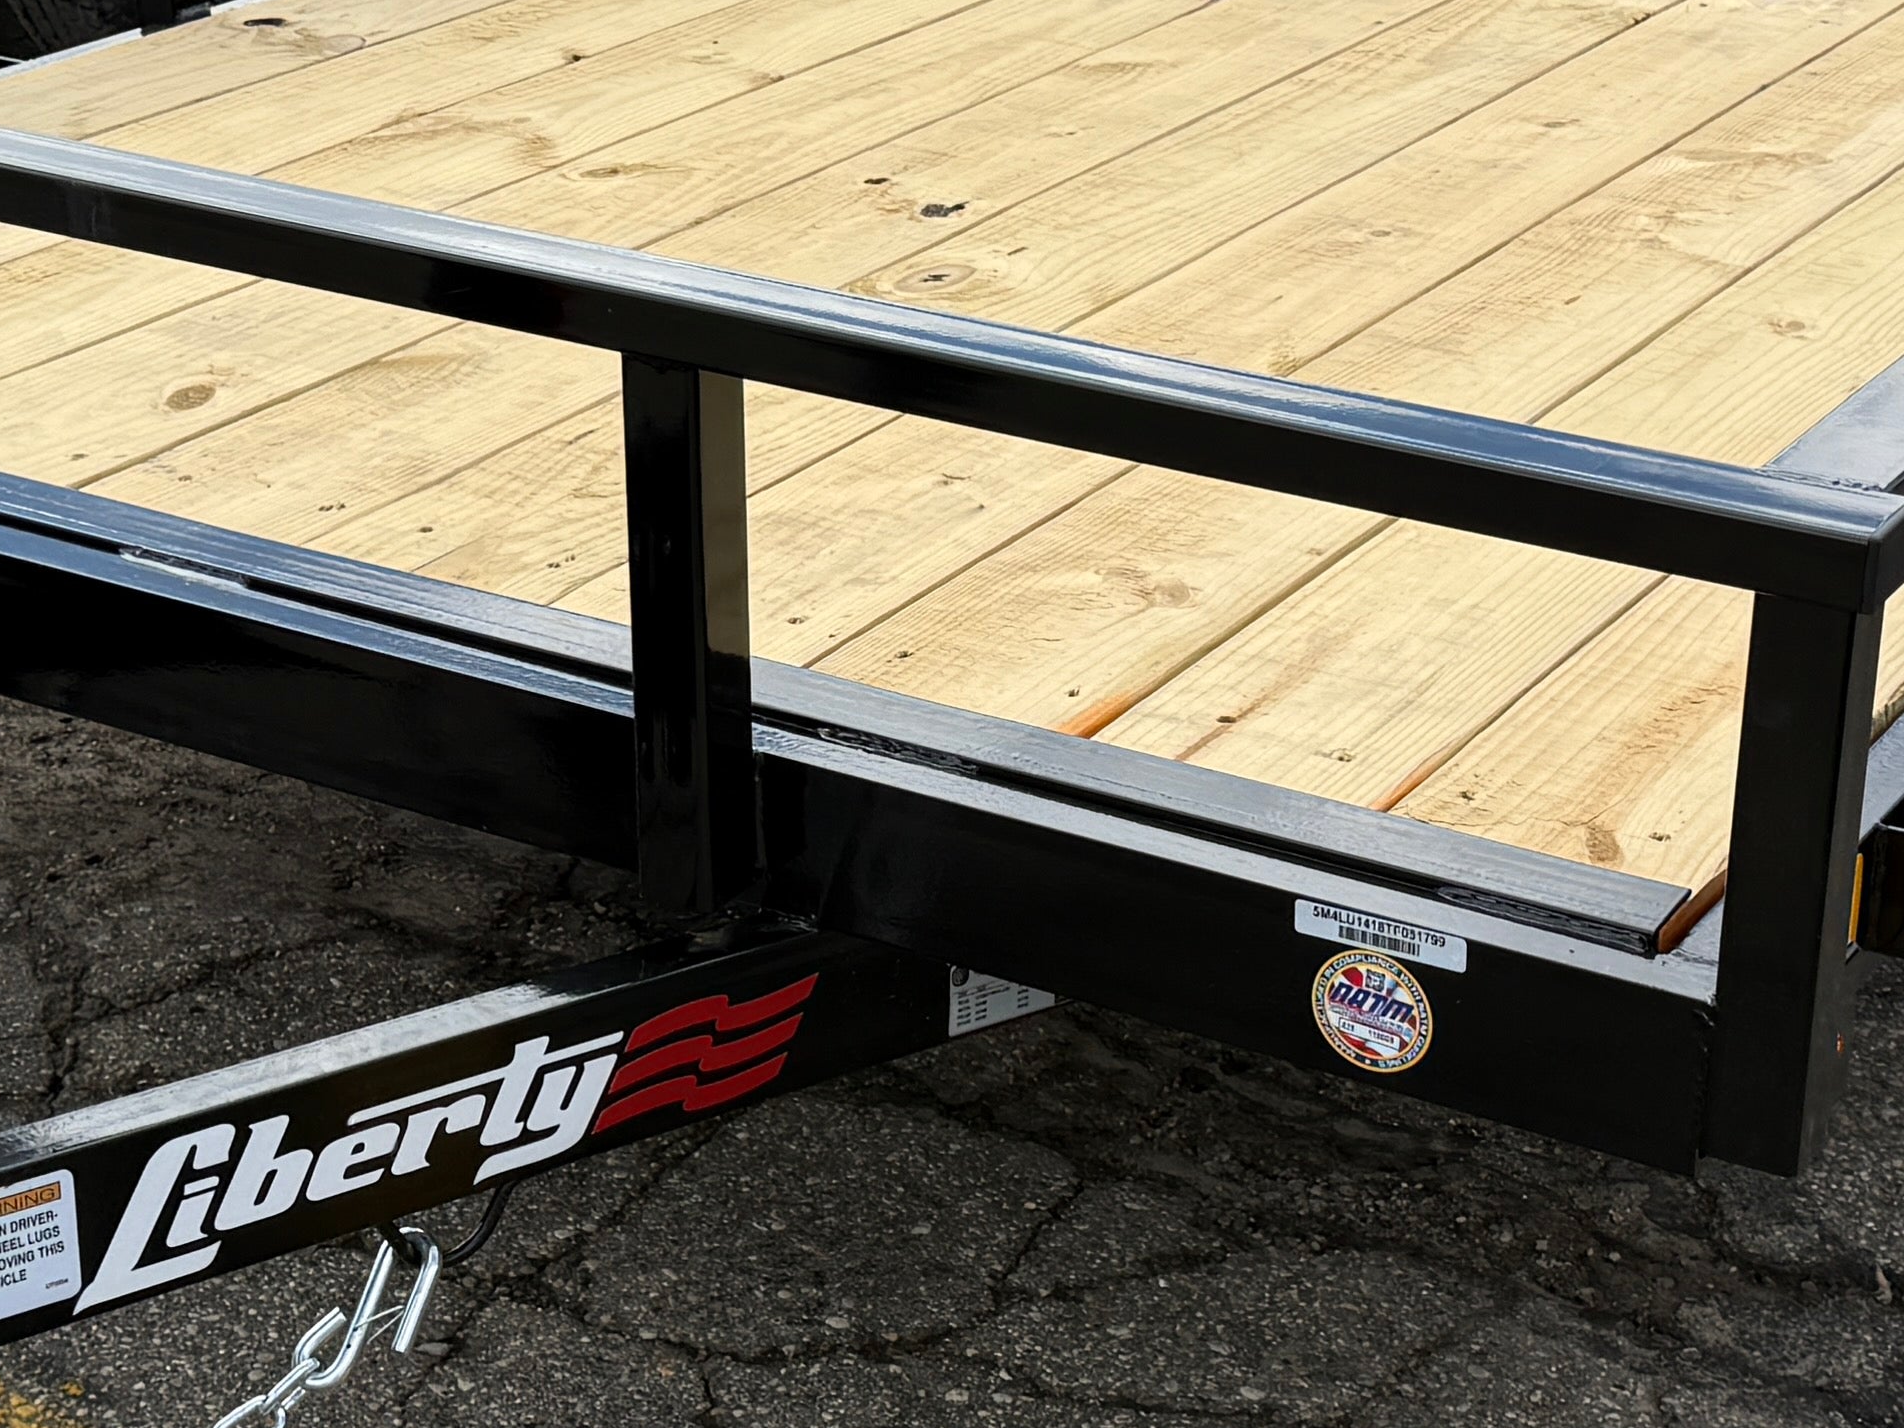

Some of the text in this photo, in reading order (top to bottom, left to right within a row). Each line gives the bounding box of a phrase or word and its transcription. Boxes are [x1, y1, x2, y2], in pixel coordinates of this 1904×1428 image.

[72, 1030, 625, 1316] Liberty
[28, 1226, 60, 1245] LUGS
[39, 1241, 64, 1258] THIS
